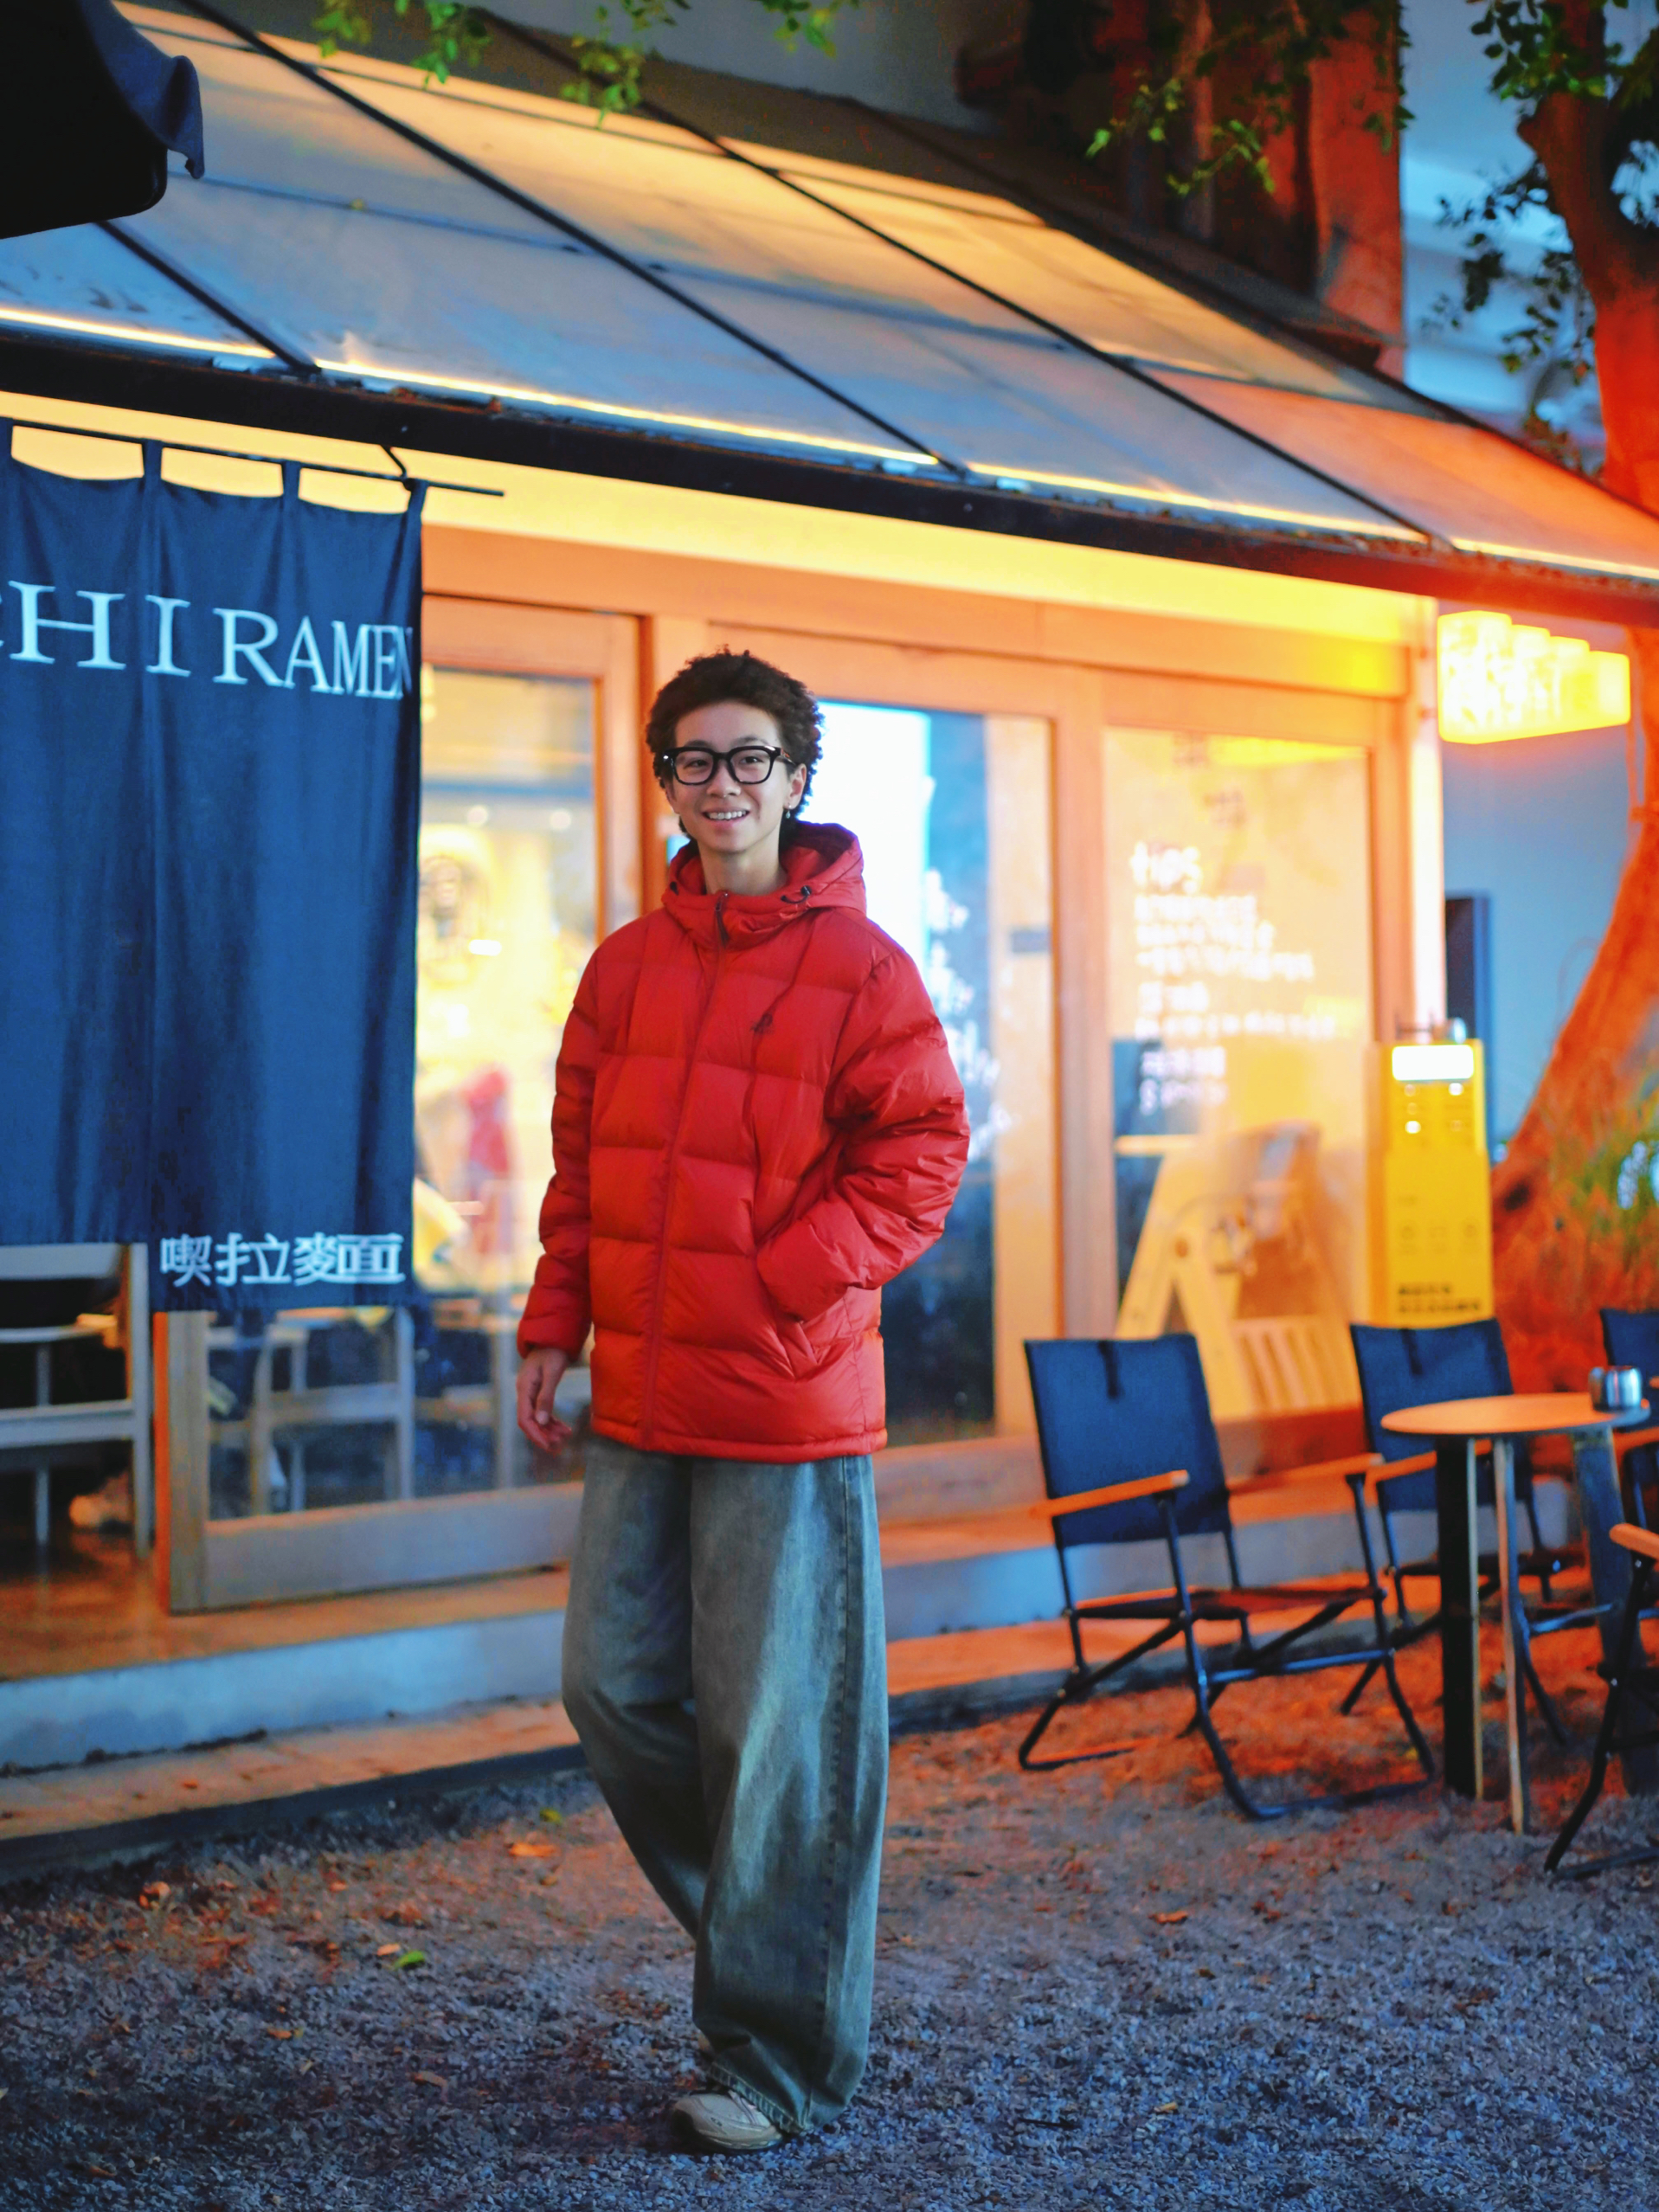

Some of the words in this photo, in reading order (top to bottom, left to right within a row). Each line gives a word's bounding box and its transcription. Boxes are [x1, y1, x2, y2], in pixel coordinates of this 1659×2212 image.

[213, 607, 414, 701] RAMEN
[159, 1231, 406, 1288] 喫拉麵
